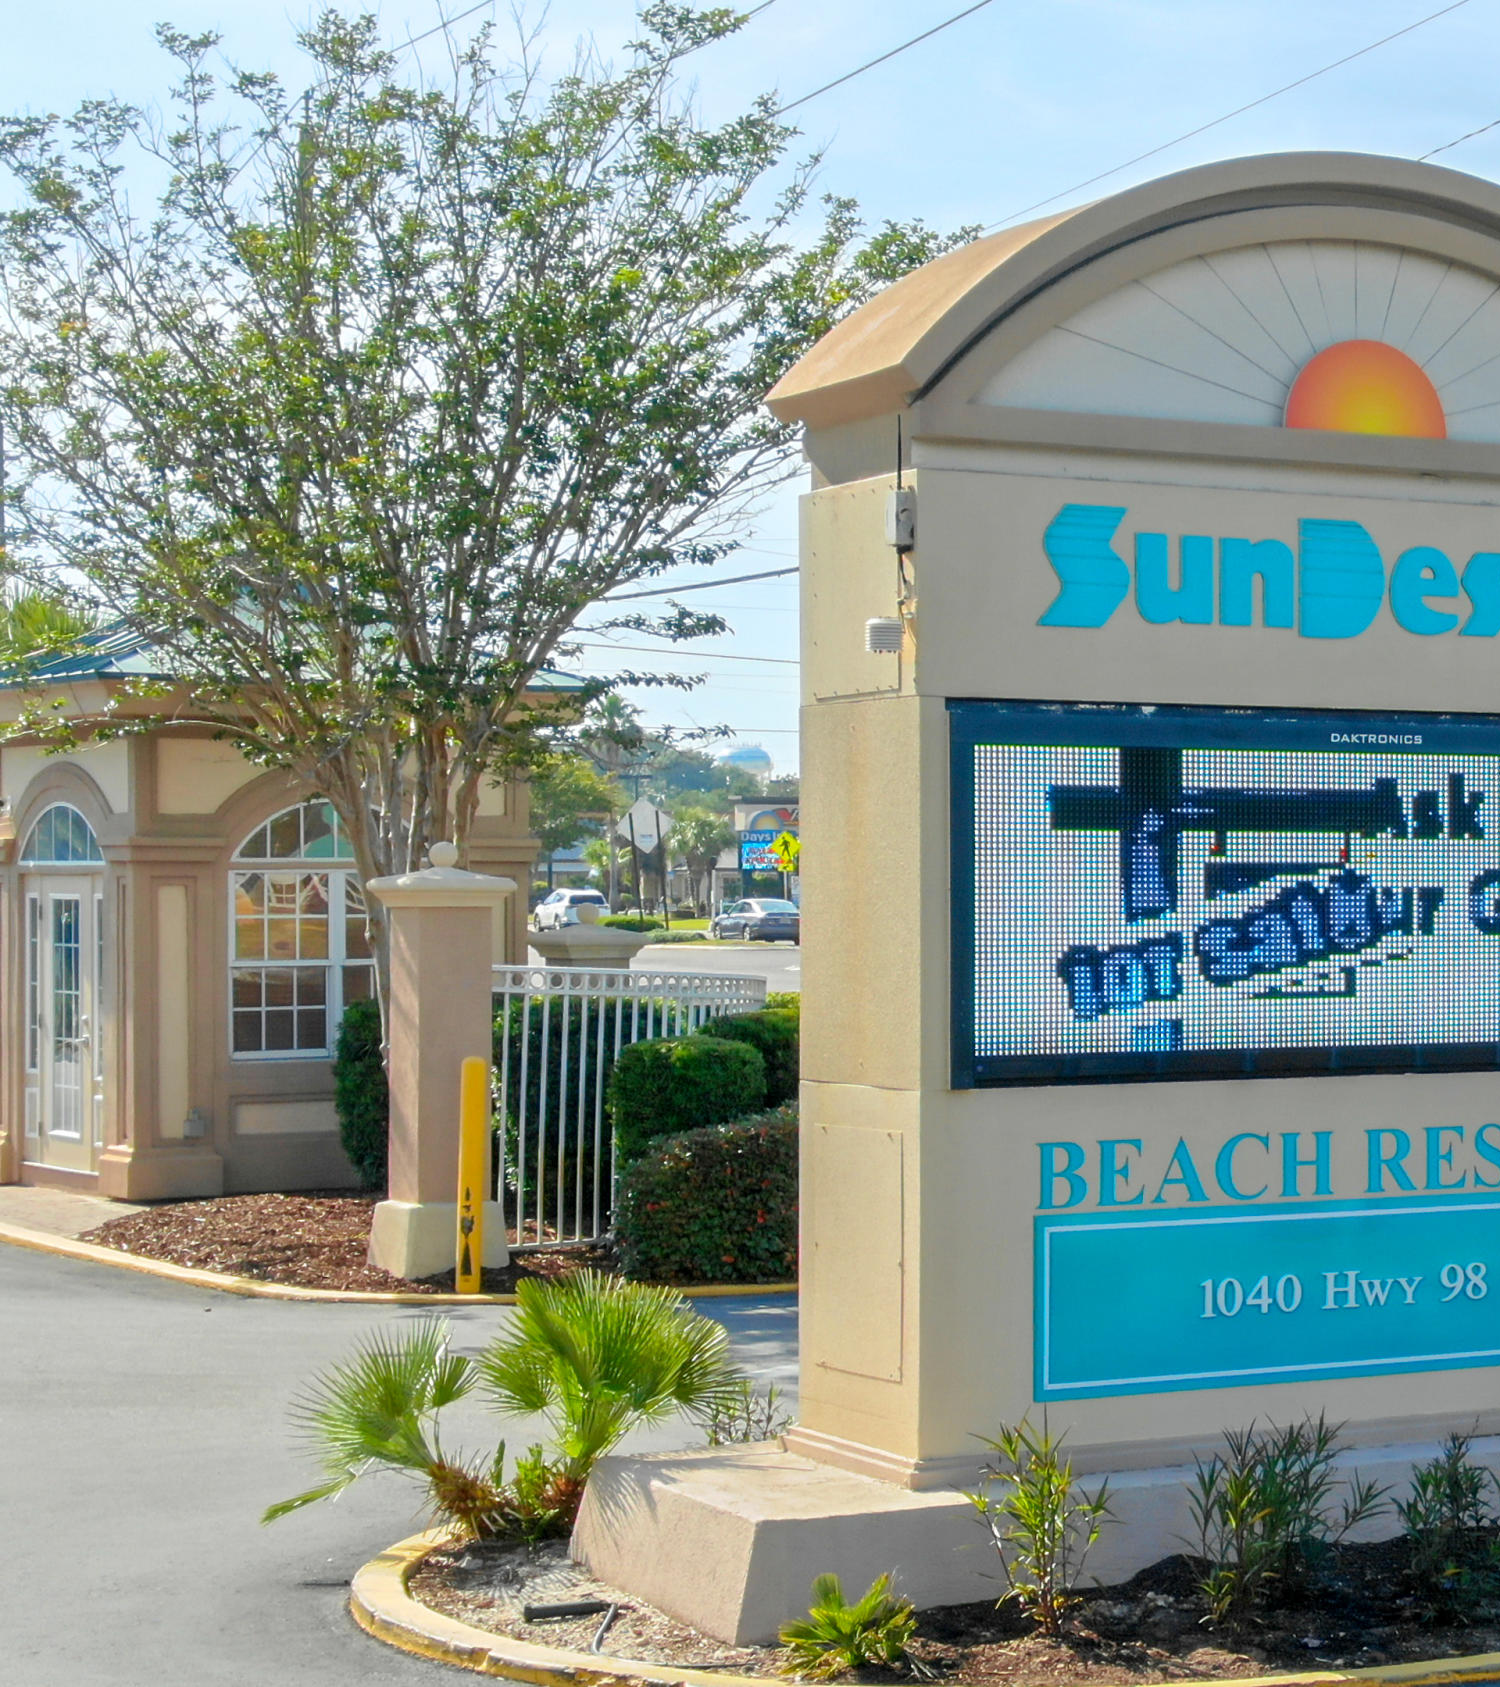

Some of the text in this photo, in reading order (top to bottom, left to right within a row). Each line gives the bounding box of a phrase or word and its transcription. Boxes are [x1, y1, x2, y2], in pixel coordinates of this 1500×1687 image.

[1330, 733, 1423, 745] DAKTRONICS
[1035, 1130, 1335, 1209] BEACH
[1200, 1274, 1302, 1319] 1040
[1440, 1261, 1489, 1304] 98
